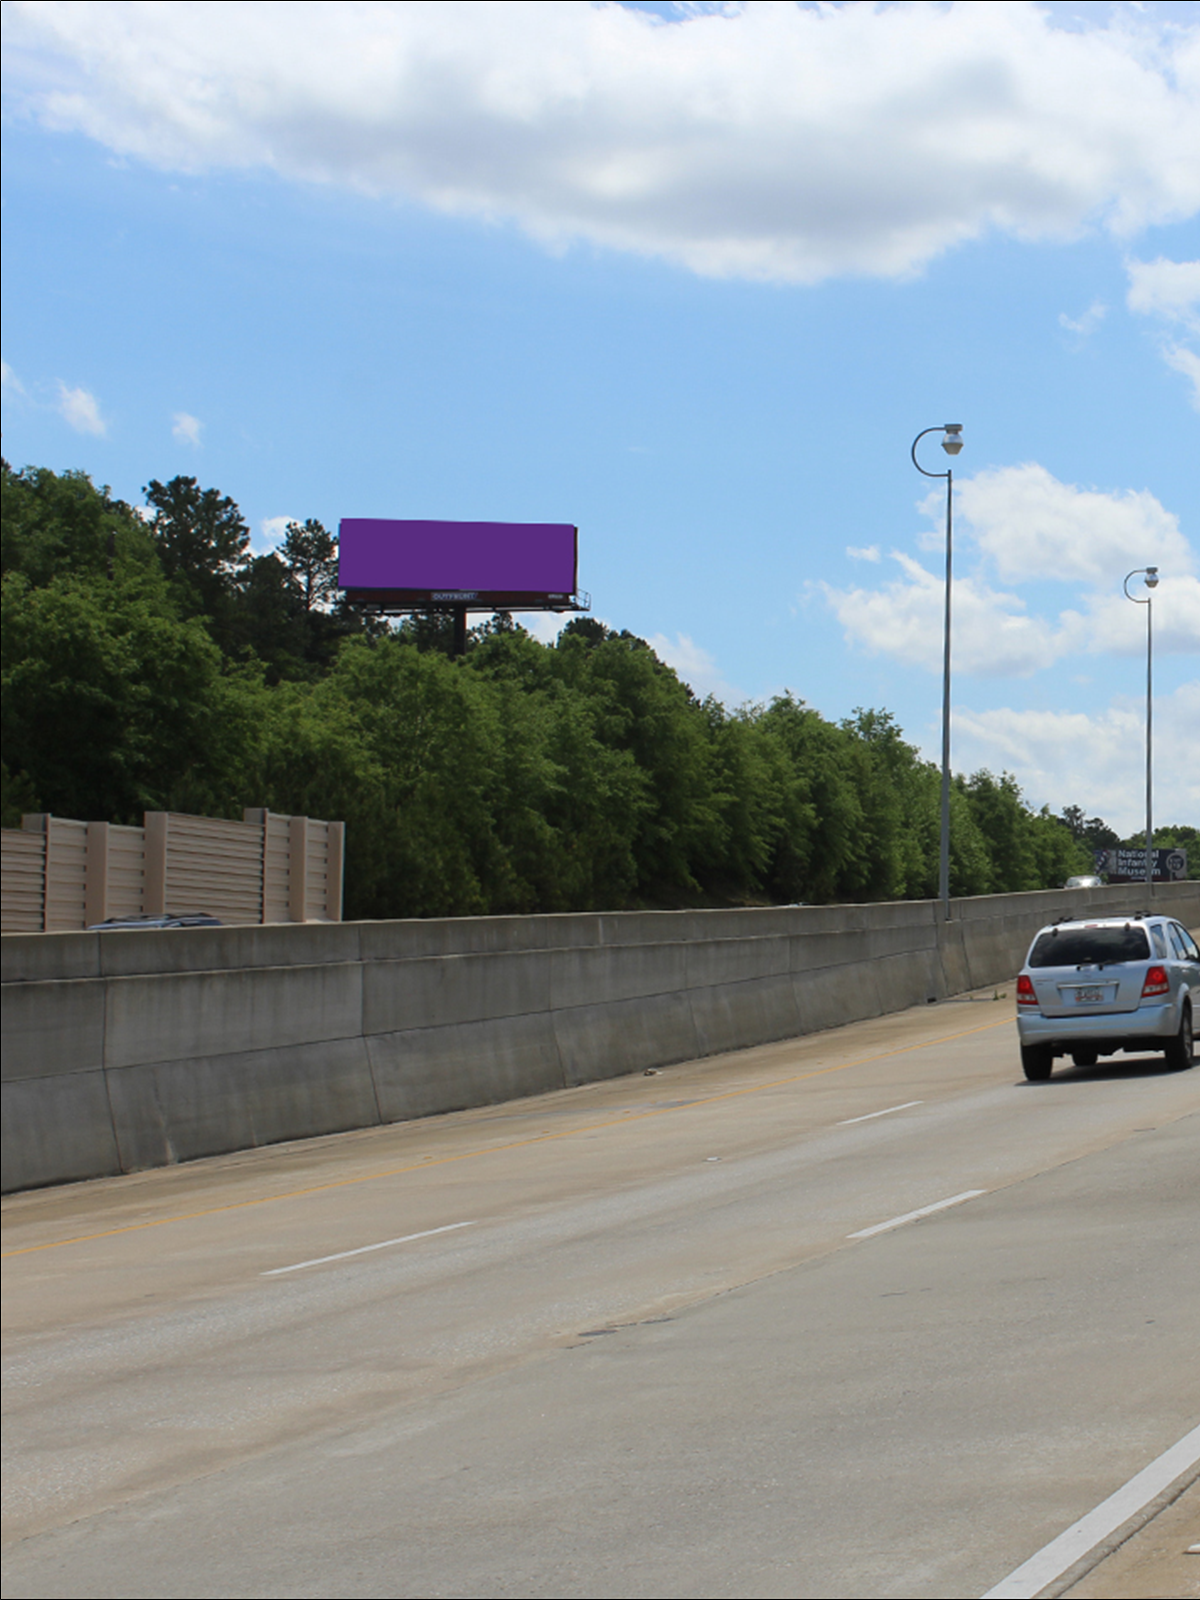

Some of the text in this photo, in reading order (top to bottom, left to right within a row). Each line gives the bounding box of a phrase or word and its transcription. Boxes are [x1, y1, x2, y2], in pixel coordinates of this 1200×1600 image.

[1118, 849, 1159, 858] Natioal
[1118, 858, 1158, 867] Infanty
[1118, 867, 1161, 875] Musem
